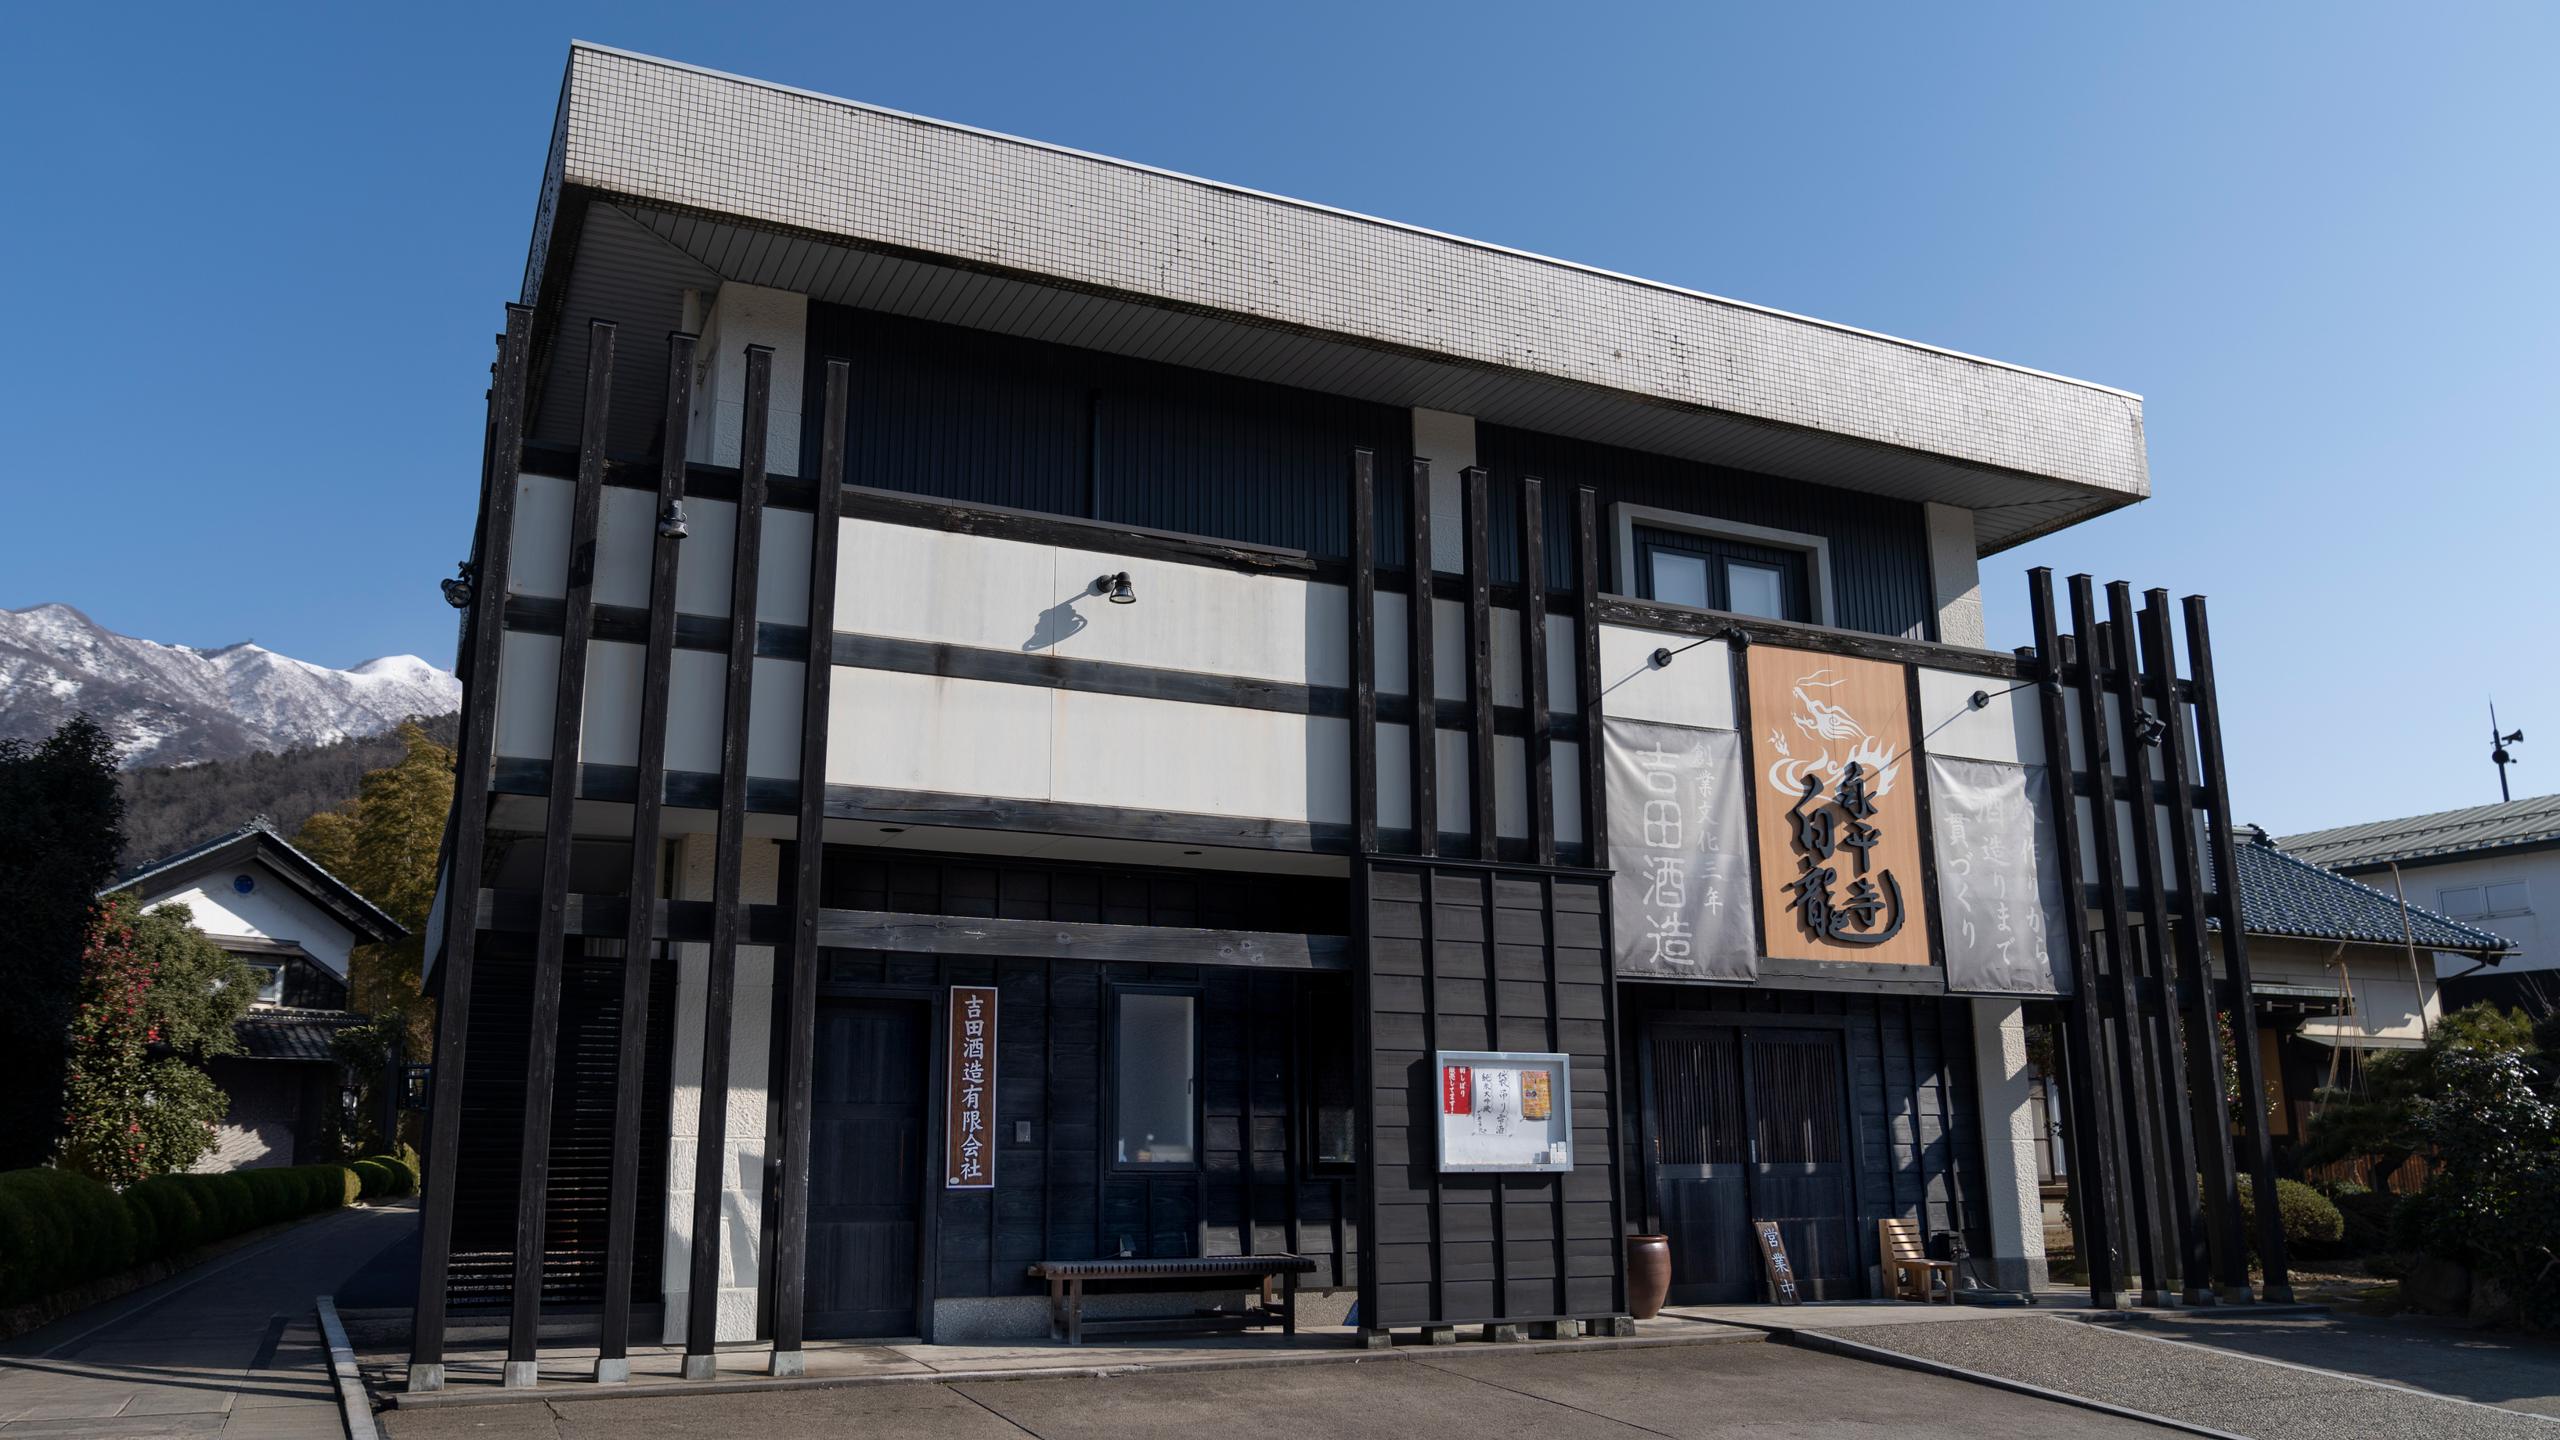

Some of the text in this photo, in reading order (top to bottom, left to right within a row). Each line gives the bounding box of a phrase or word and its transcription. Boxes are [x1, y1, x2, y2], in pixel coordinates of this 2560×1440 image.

[1636, 741, 1694, 965] 吉田酒造
[1690, 742, 1724, 915] 創業文化三年
[1975, 786, 2016, 966] 酒造りまで
[960, 994, 985, 1180] 吉田酒造有限会社
[1763, 1227, 1795, 1300] 営業中
